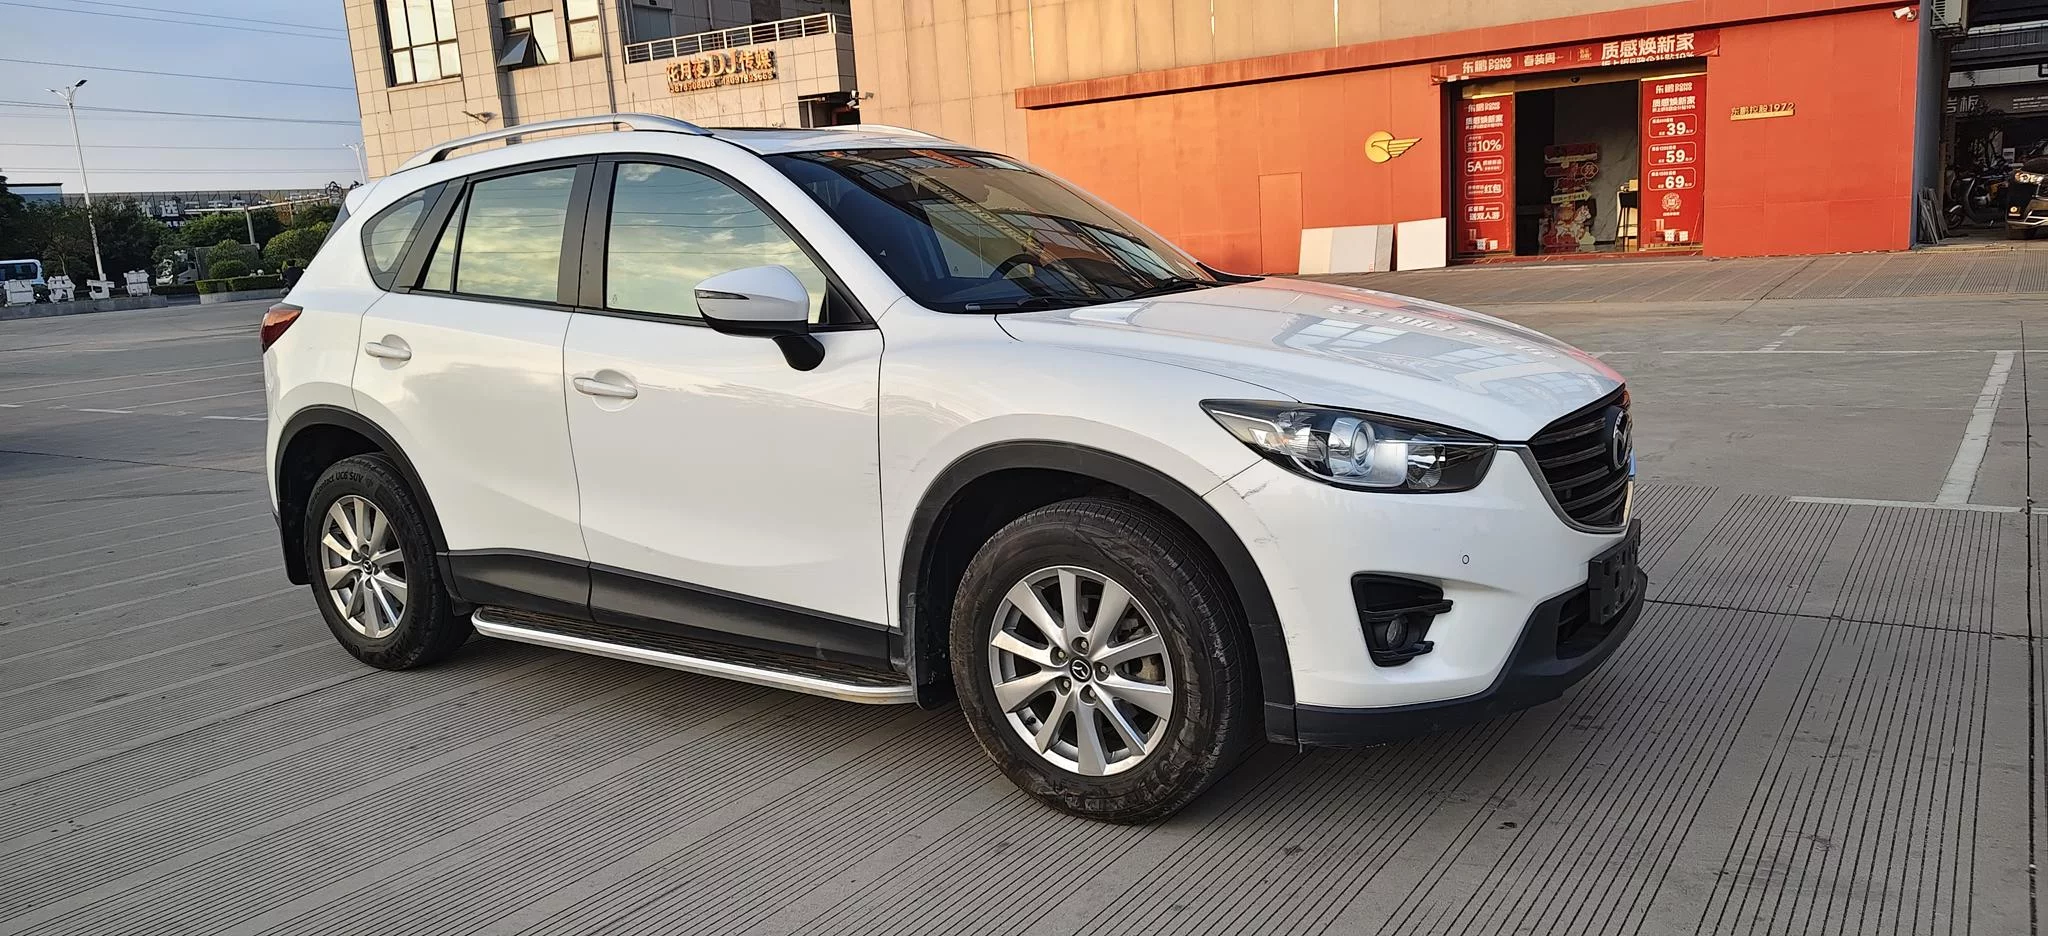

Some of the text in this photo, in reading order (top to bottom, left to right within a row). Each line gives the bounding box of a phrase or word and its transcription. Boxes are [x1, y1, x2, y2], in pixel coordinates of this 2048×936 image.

[1601, 33, 1695, 60] 质感焕新家
[1463, 60, 1487, 74] 东鹏
[1666, 122, 1686, 136] 39
[1477, 139, 1502, 151] 10%
[1666, 149, 1686, 163] 59
[1467, 160, 1483, 172] 5A
[1483, 183, 1502, 194] 红包
[1665, 175, 1685, 189] 69
